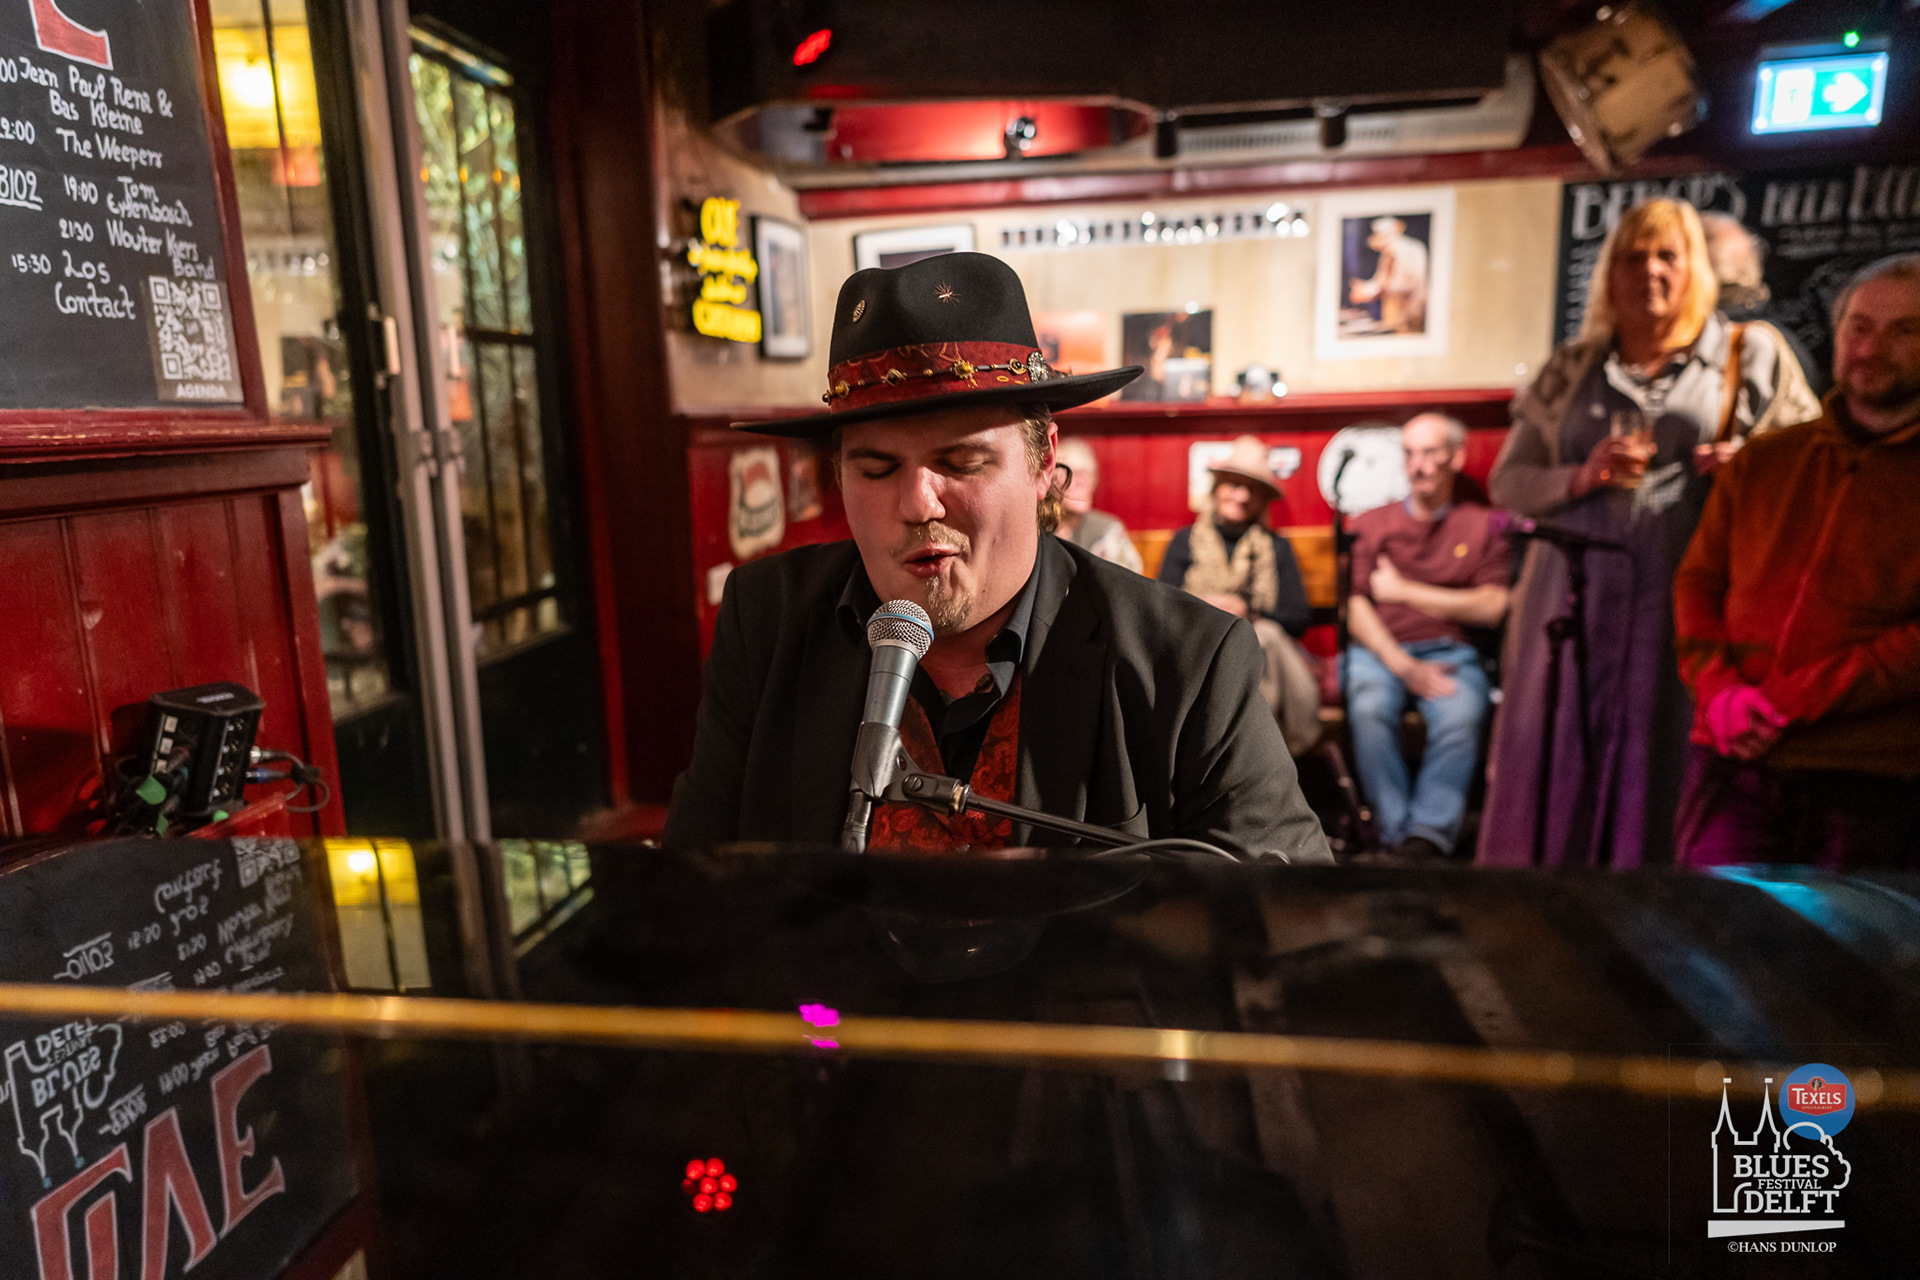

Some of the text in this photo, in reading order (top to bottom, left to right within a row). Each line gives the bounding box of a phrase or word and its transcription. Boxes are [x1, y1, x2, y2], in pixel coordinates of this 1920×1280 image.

[19, 56, 59, 88] Jean
[69, 65, 107, 101] Paul
[157, 88, 173, 118] &
[49, 88, 79, 121] Bas
[0, 116, 163, 170] 2:00 The Weepers
[64, 175, 98, 204] 19:00
[117, 176, 159, 203] Tom
[106, 218, 163, 254] Wouter
[12, 254, 51, 275] 15:30
[172, 256, 216, 280] Band
[55, 281, 136, 320] Contact
